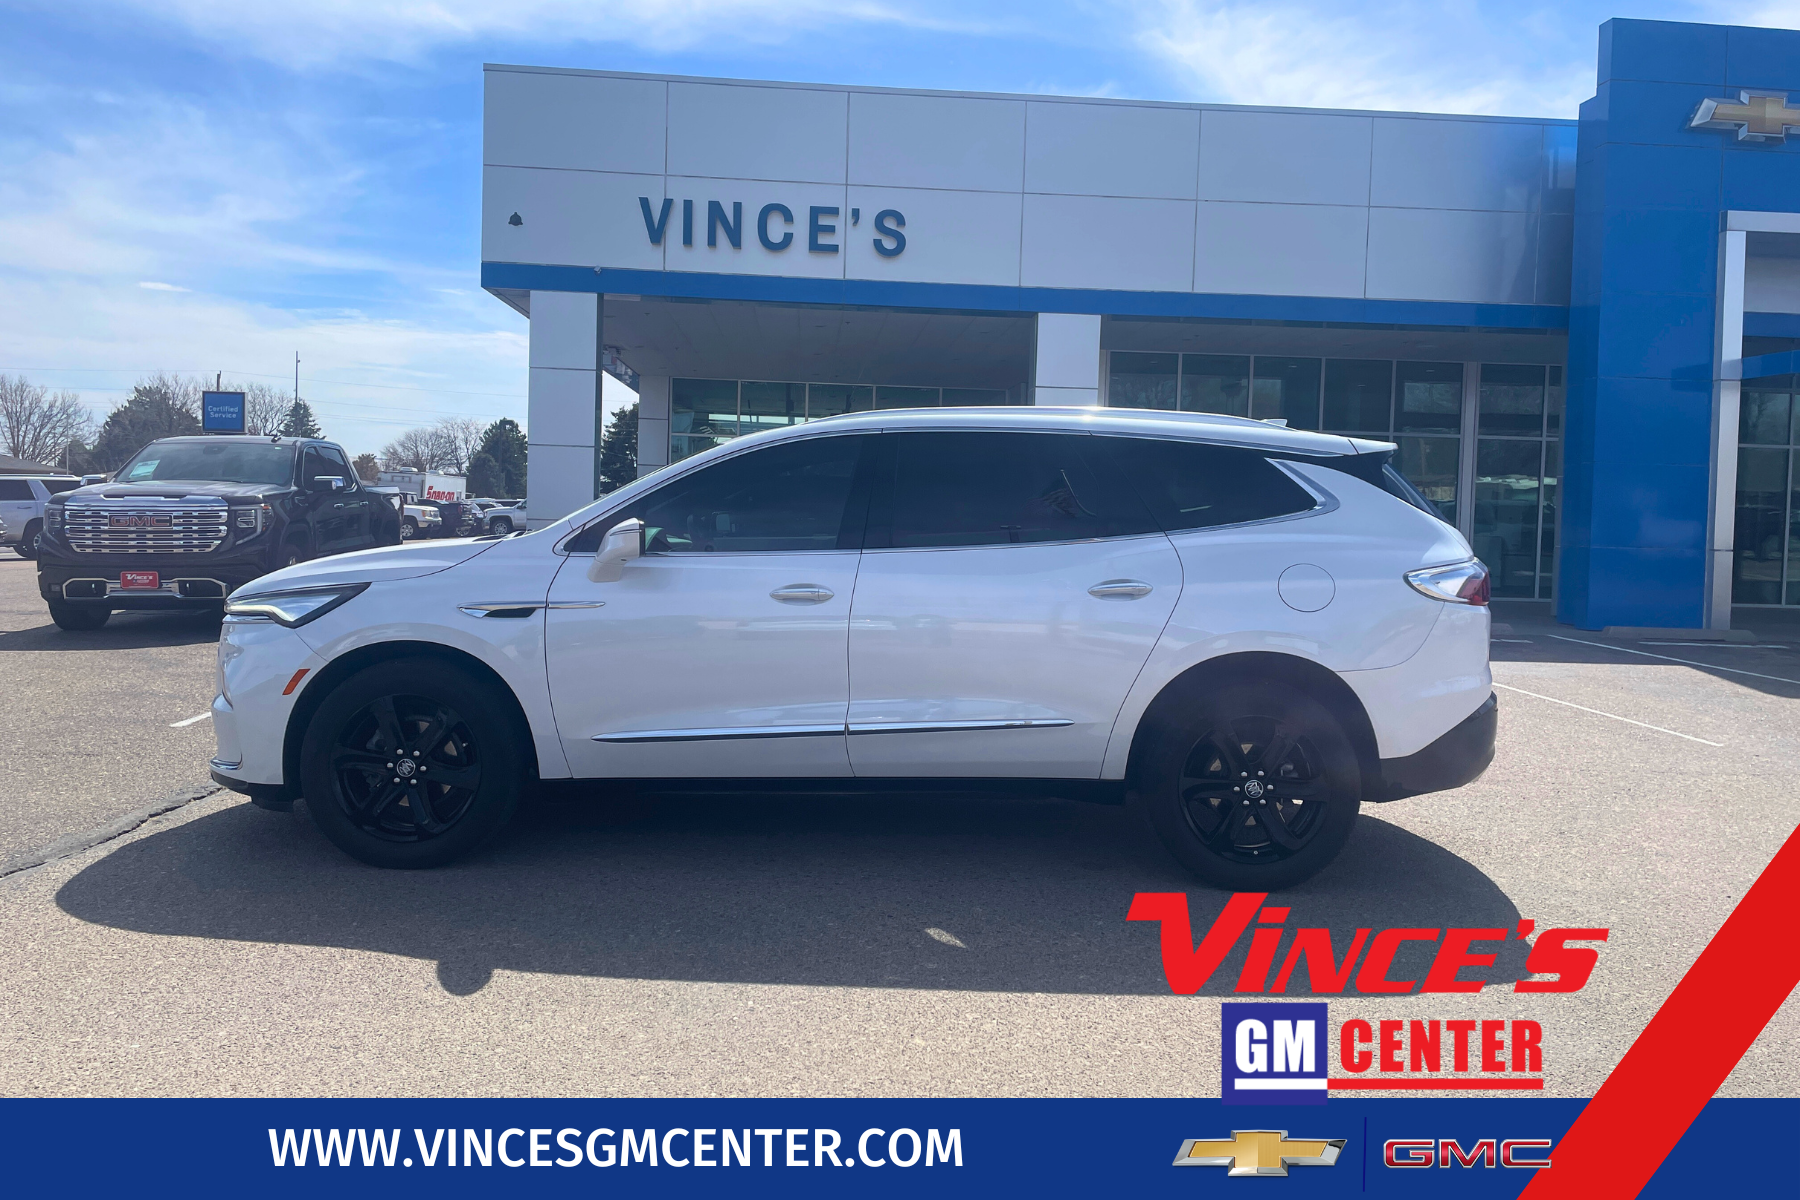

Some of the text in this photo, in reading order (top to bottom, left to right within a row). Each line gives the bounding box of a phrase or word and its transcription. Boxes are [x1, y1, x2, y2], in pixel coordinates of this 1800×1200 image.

[638, 196, 907, 258] VINCE'S
[208, 405, 239, 413] Certified
[210, 411, 237, 419] Service
[111, 516, 170, 527] GMC
